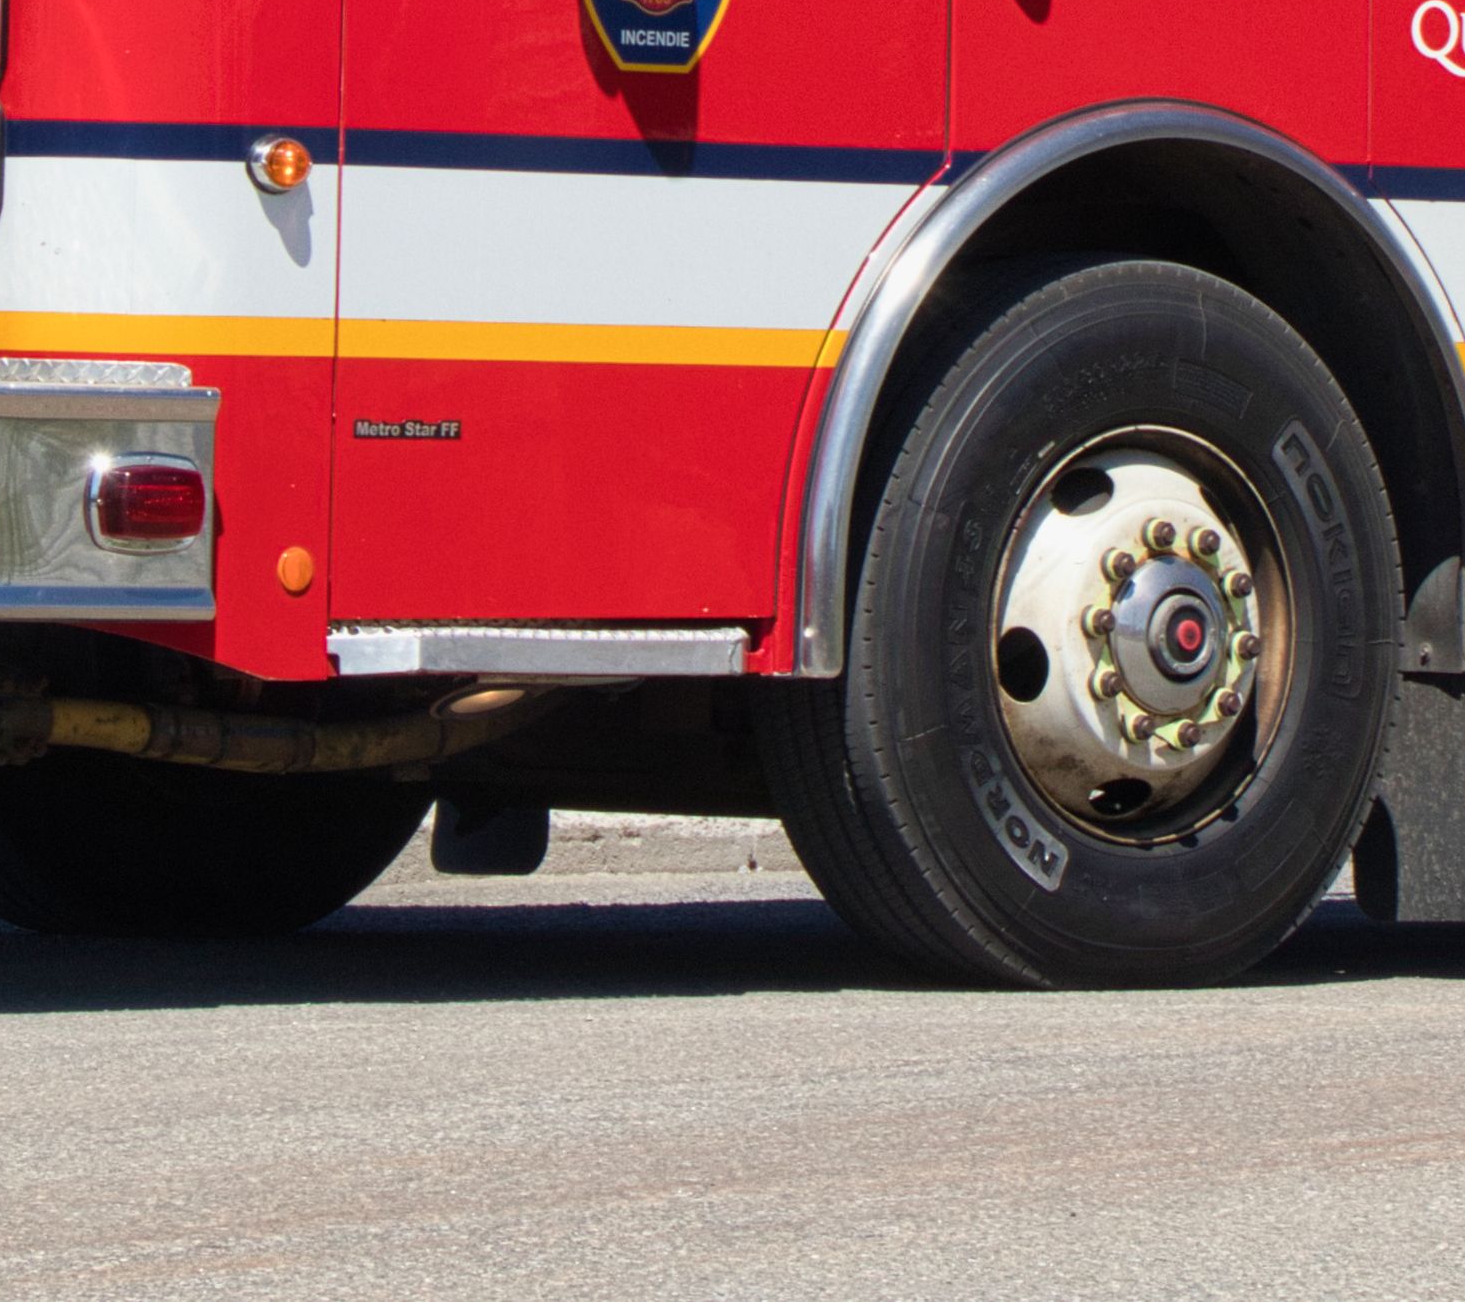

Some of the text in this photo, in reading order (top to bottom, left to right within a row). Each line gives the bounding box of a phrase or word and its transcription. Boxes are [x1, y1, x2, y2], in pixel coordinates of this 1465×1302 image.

[620, 28, 691, 48] INCENDIE
[355, 421, 460, 437] Metro Star FF
